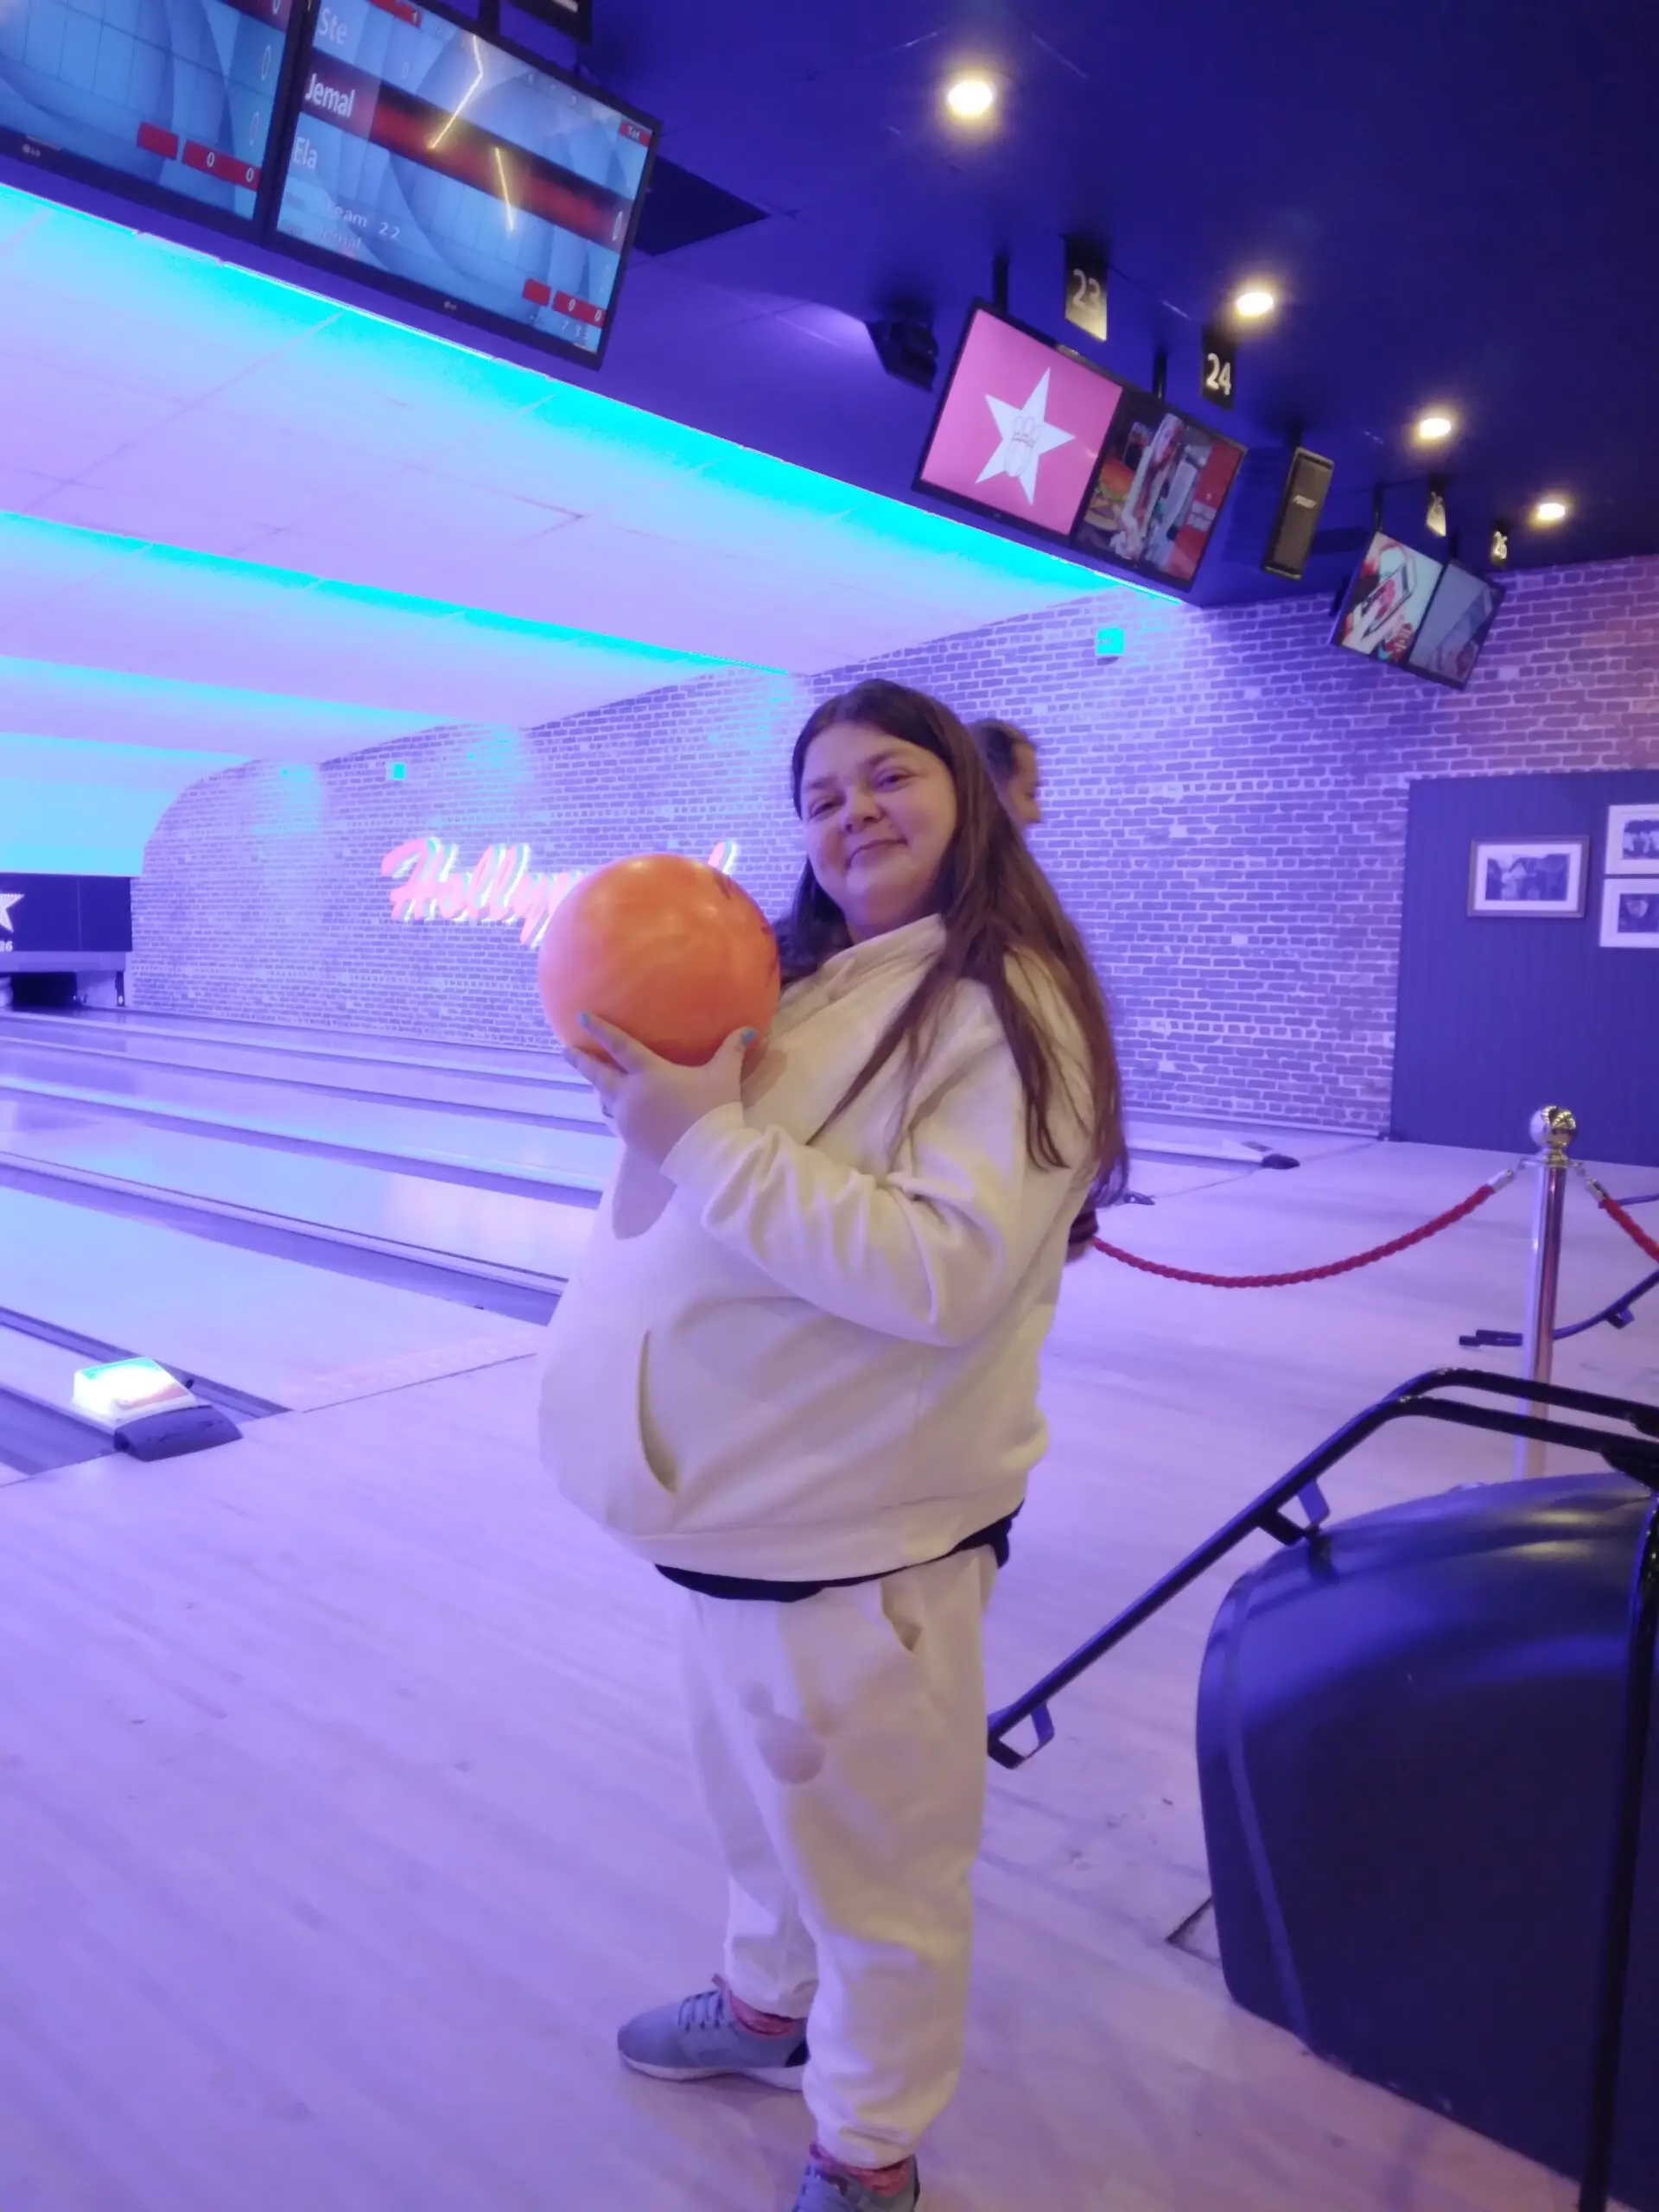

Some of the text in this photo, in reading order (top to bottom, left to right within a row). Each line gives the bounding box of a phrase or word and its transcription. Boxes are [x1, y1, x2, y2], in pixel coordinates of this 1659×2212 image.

[304, 72, 356, 118] Jemal
[207, 151, 254, 183] 0 0
[292, 137, 318, 170] Ela
[378, 221, 401, 240] 22
[1072, 268, 1102, 309] 23
[569, 299, 602, 322] 0 0
[1206, 353, 1232, 396] 24
